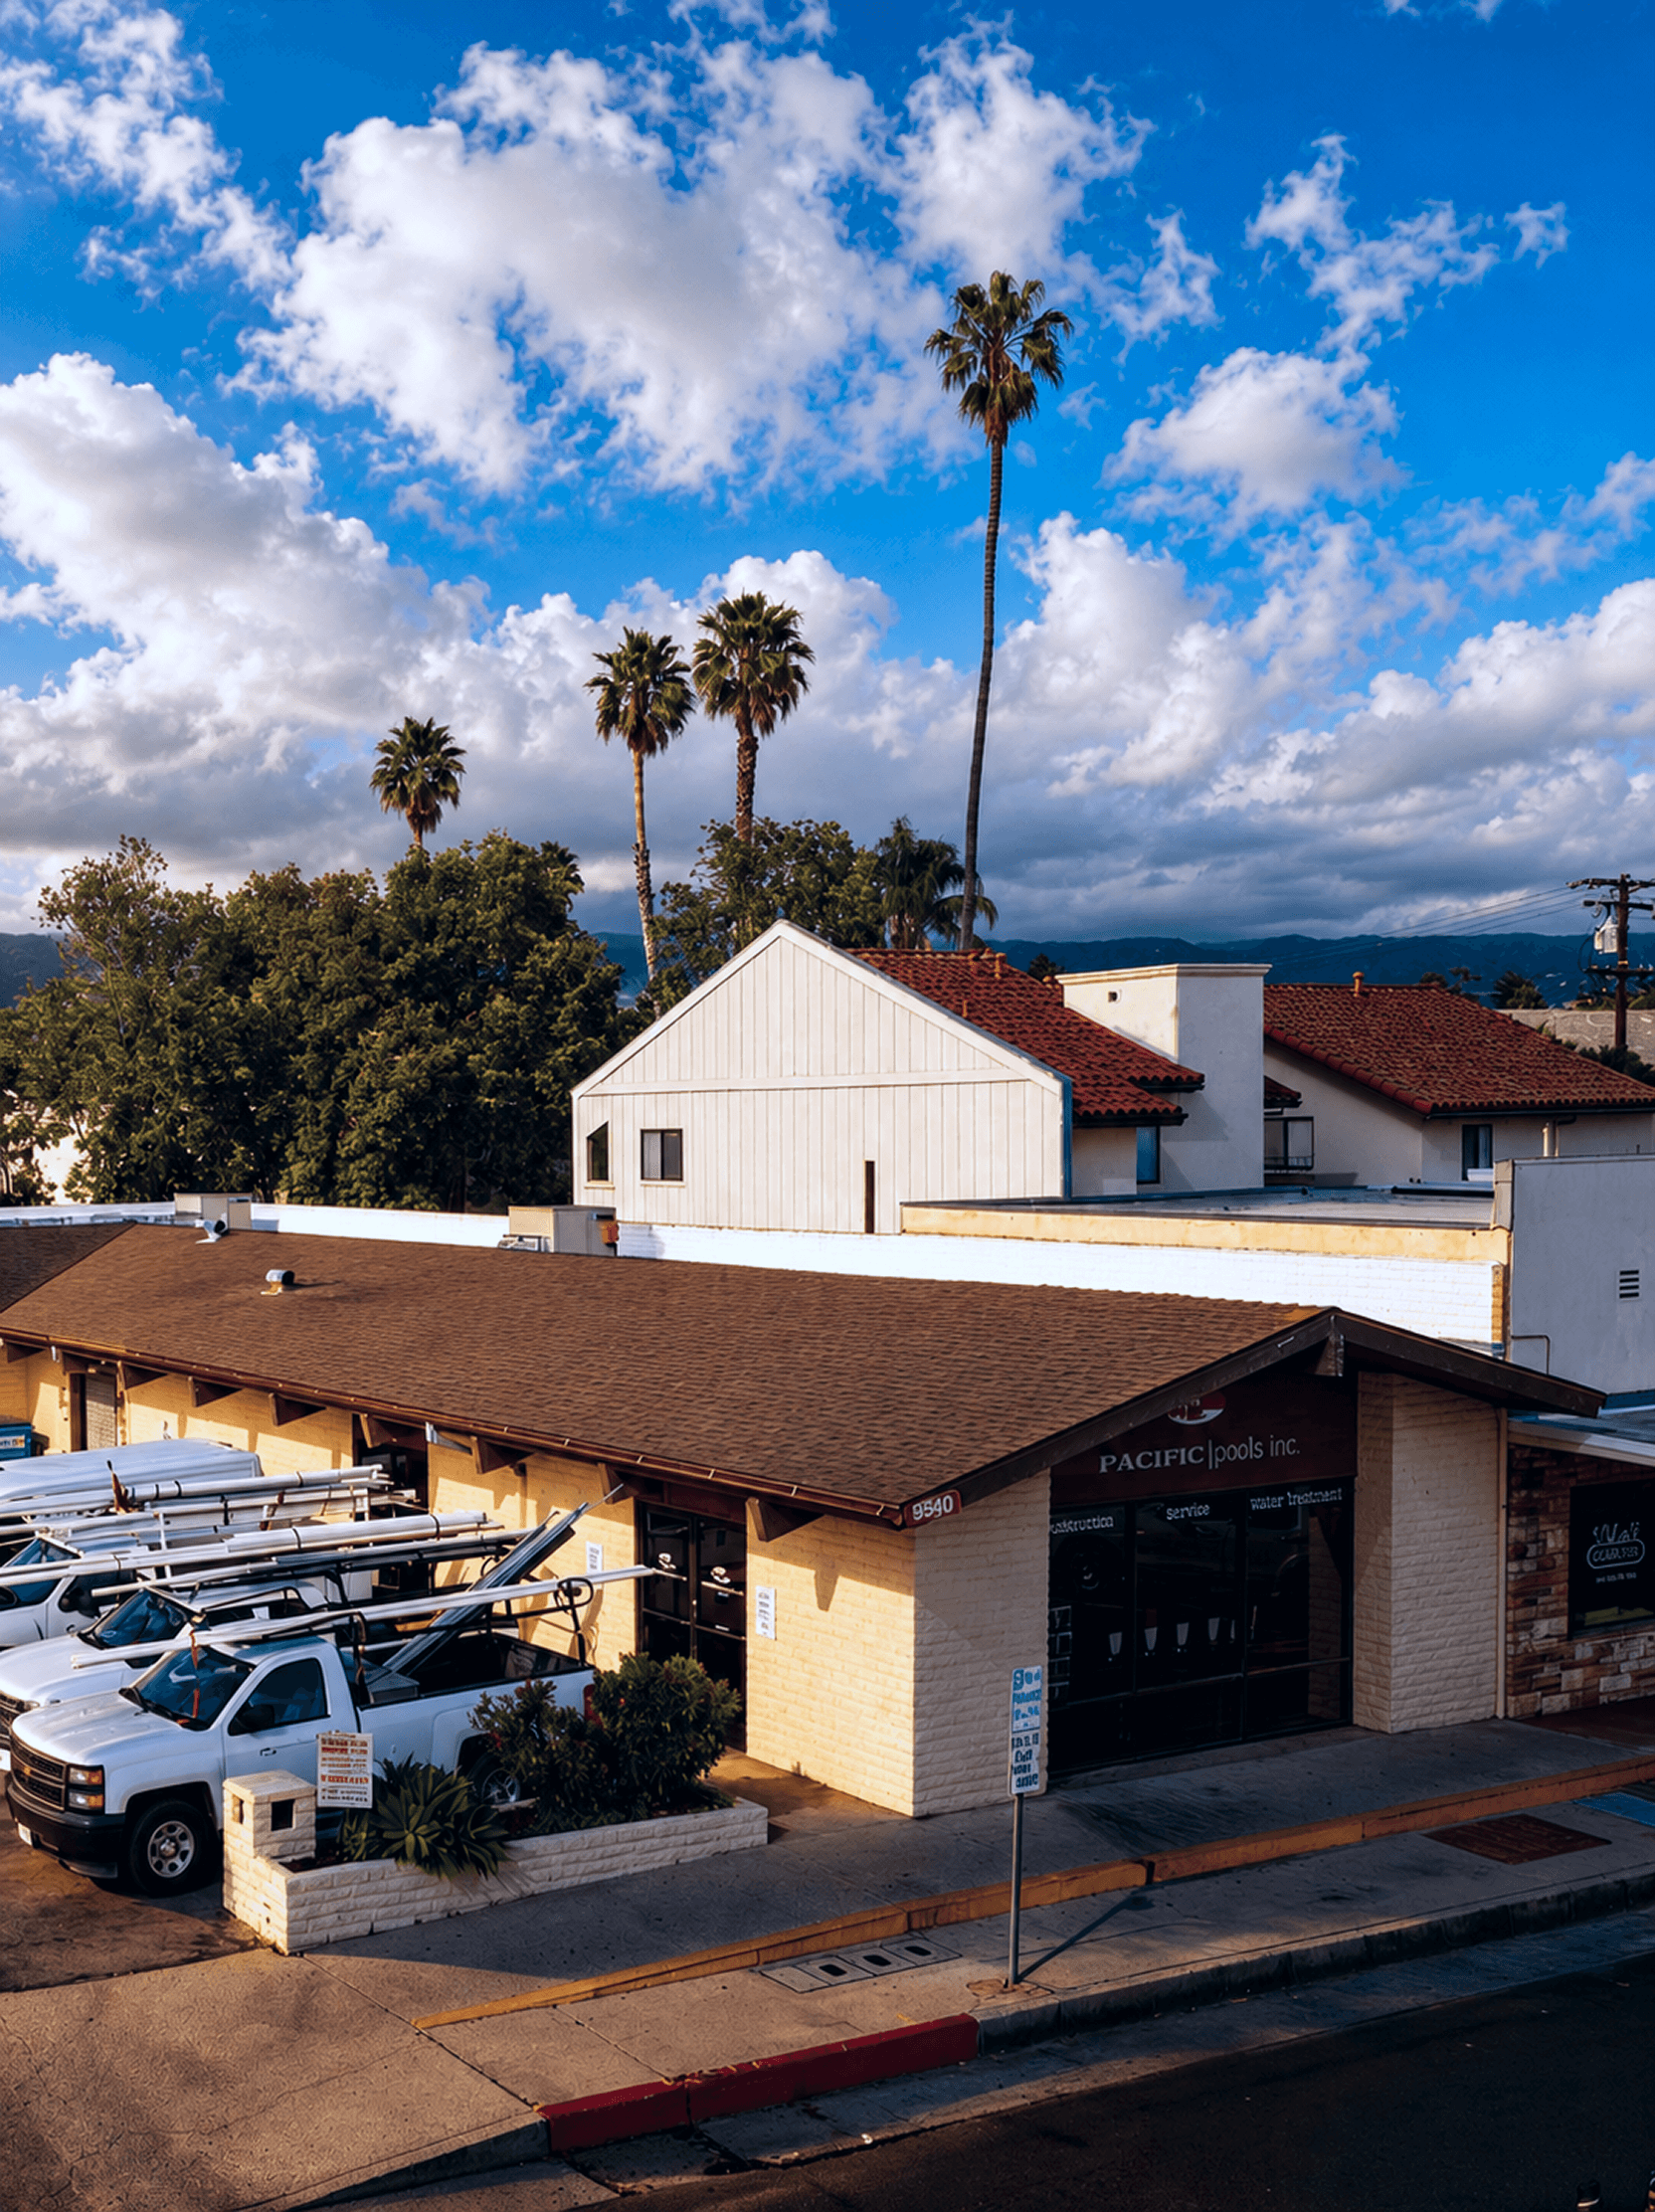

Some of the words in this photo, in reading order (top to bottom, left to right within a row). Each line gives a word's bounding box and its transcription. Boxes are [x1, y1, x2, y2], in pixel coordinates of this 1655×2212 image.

[1099, 1446, 1204, 1474] PACIFIC
[1269, 1434, 1301, 1457] inc.
[912, 1495, 954, 1521] 9540
